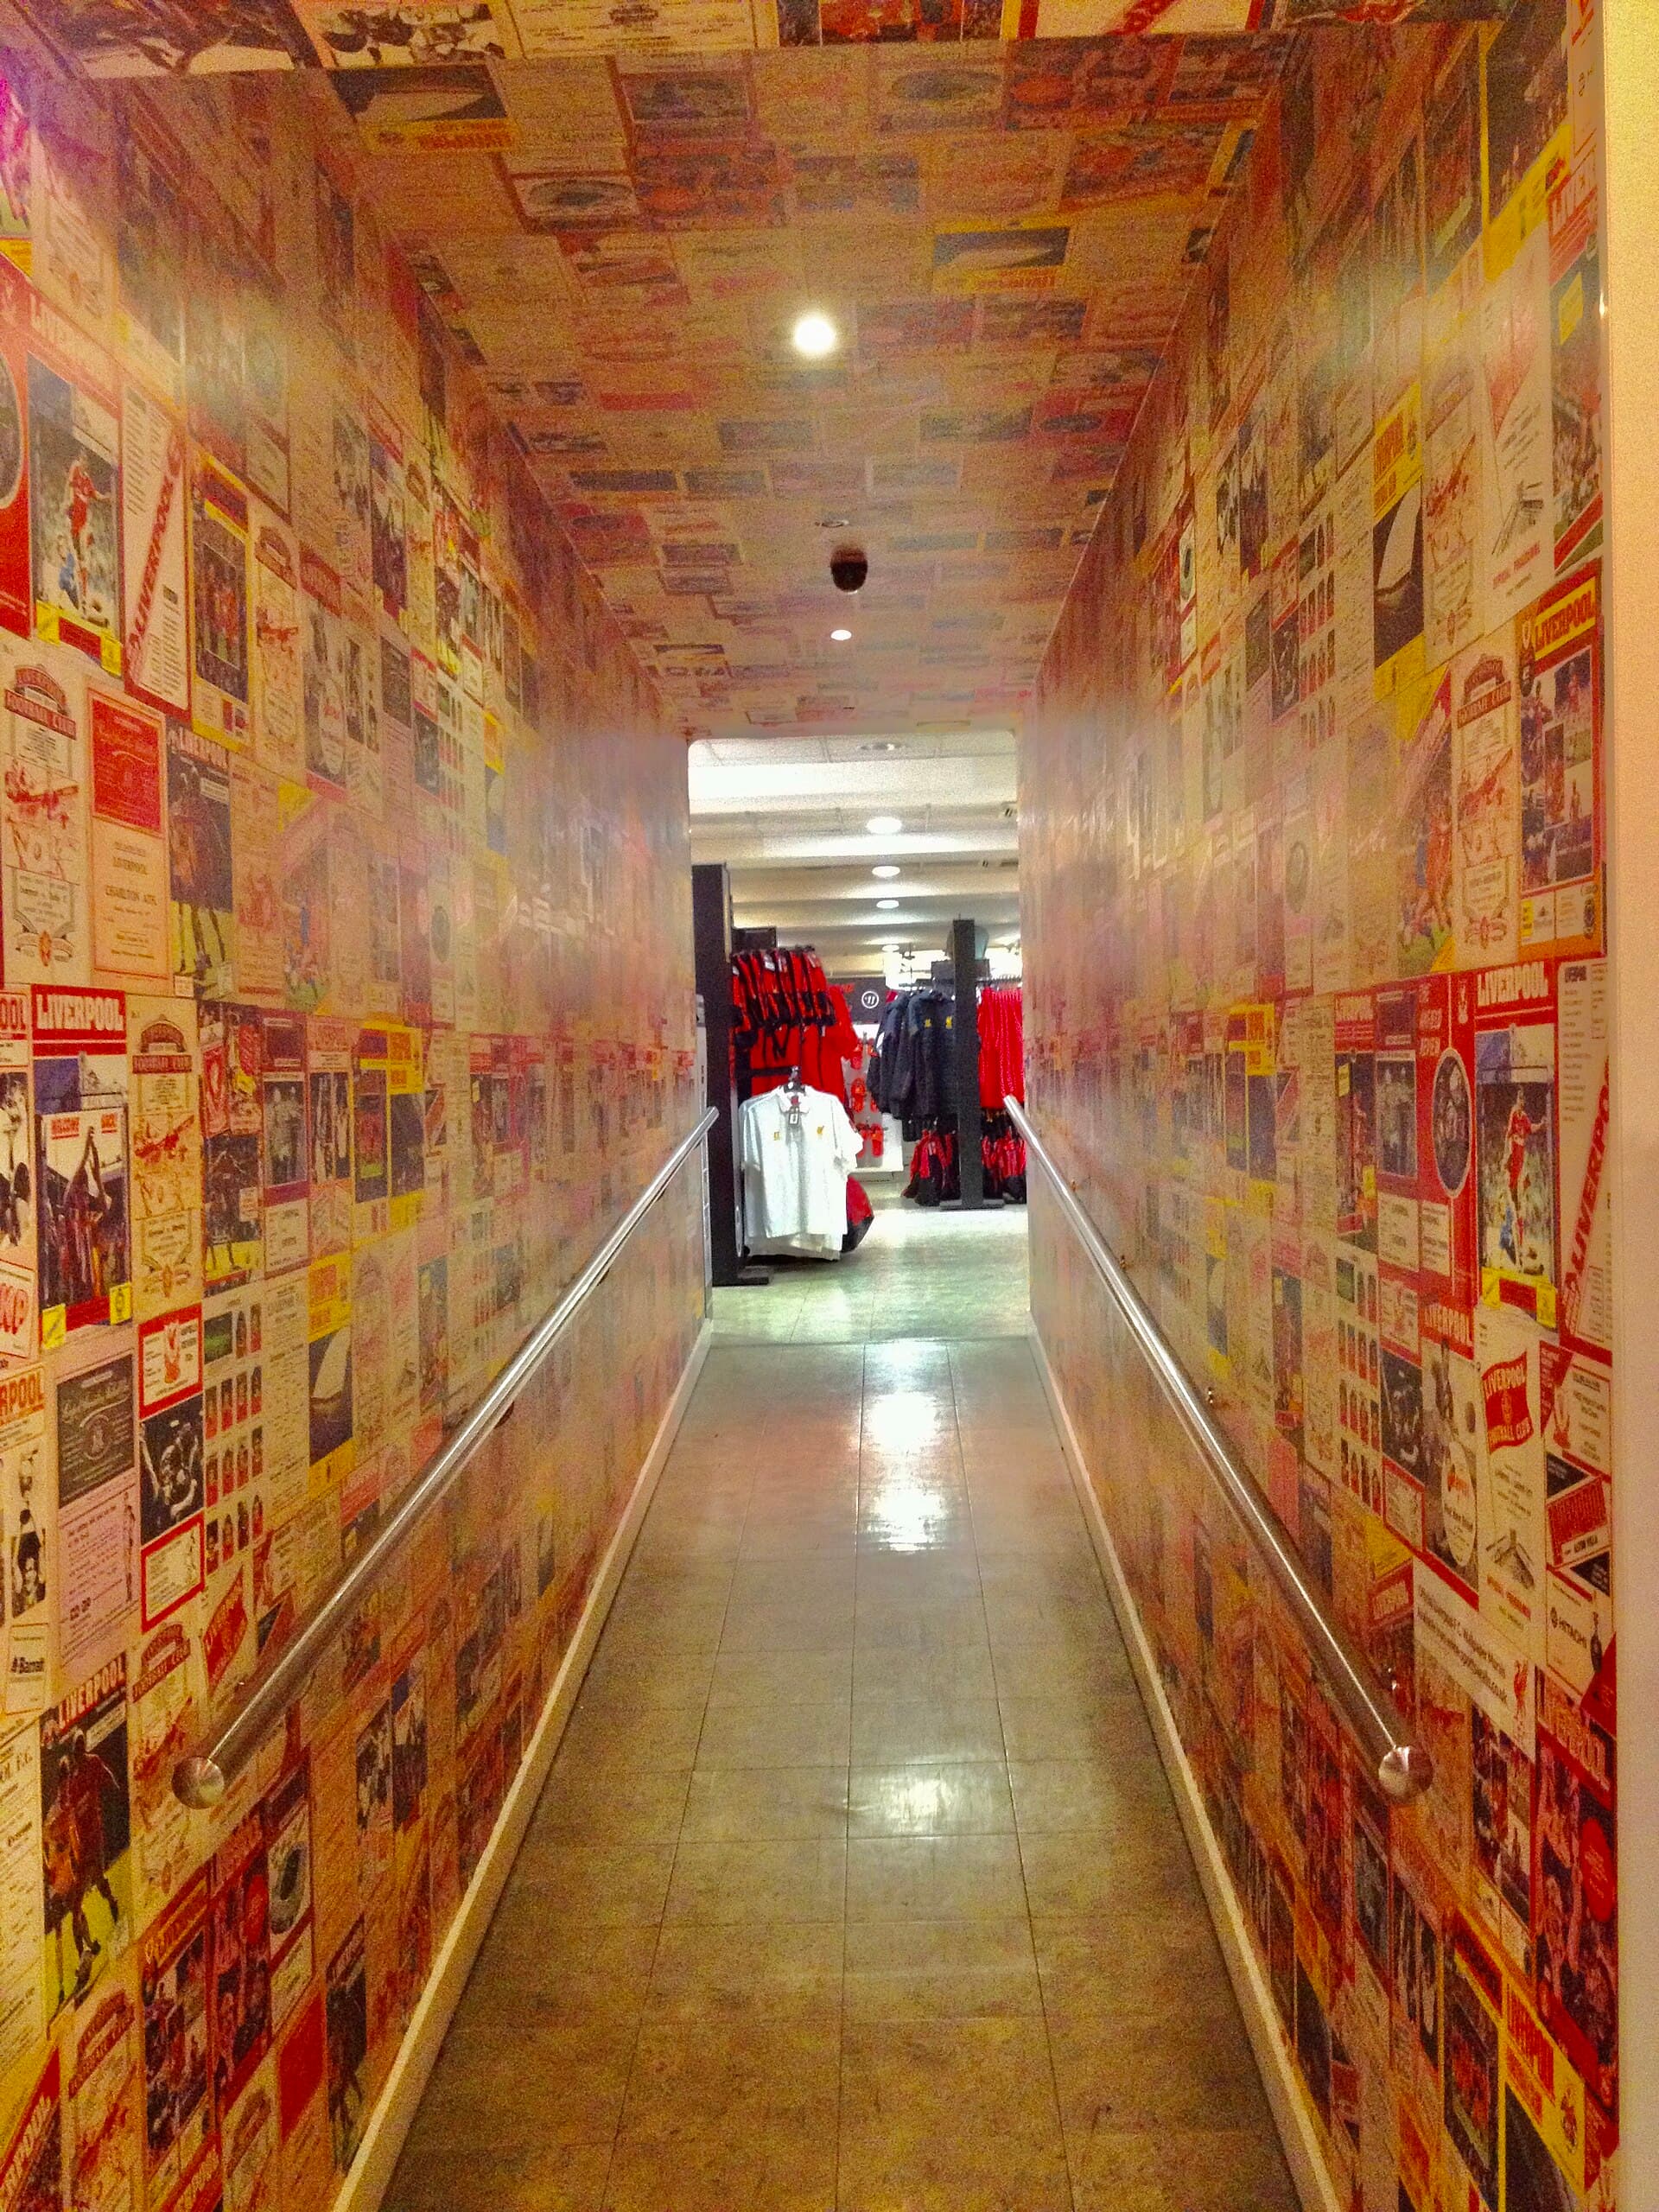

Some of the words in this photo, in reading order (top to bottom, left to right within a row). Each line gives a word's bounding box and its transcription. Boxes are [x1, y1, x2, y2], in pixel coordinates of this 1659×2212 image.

[1535, 590, 1595, 652] LIVERPOOL
[1478, 961, 1548, 1007] LIVERPOOL
[36, 994, 124, 1032] LIVERPOOL
[1484, 1363, 1525, 1400] LIVERPOOL
[59, 1653, 125, 1729] LIVERPOOL
